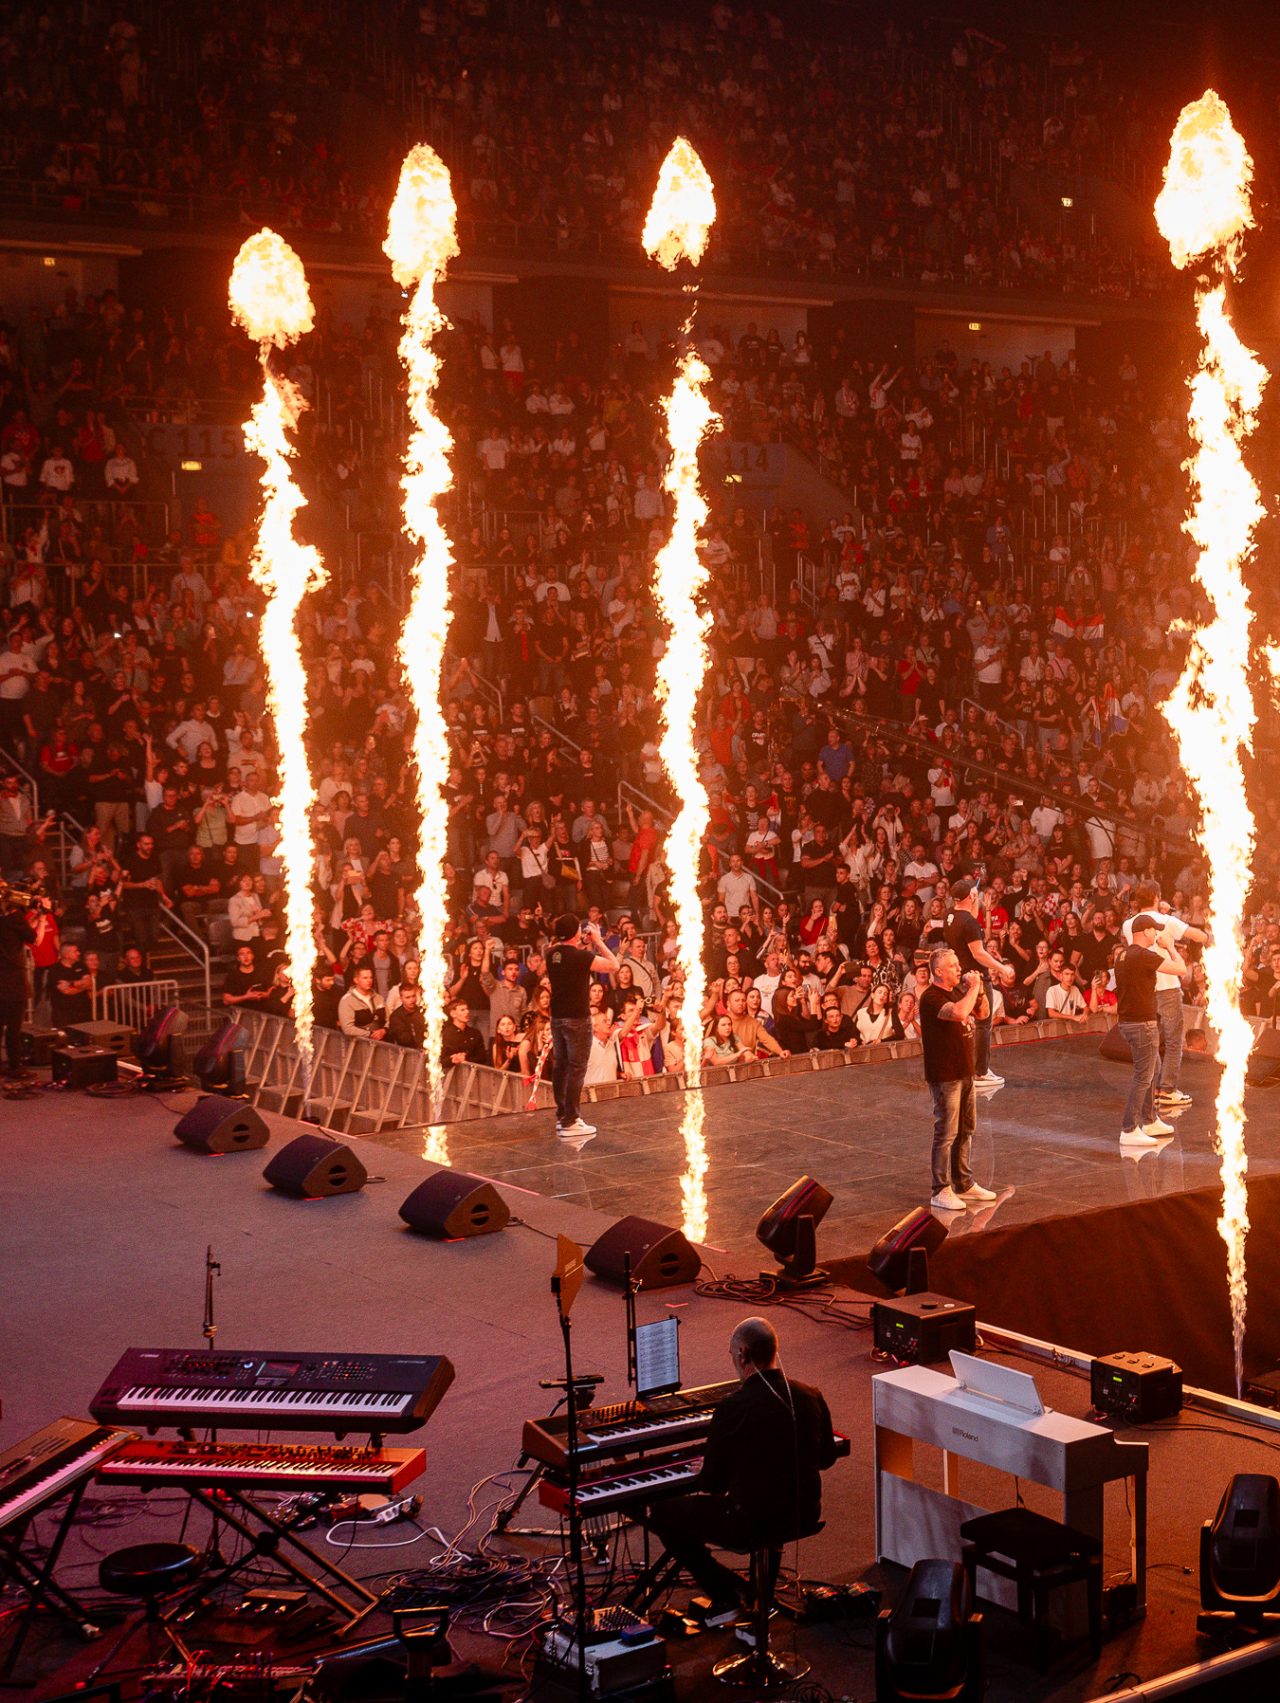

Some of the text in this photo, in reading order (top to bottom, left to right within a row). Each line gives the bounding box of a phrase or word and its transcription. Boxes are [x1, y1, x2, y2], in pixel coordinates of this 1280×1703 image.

[176, 427, 237, 459] 115
[722, 446, 769, 473] 114
[960, 1429, 979, 1441] Roland
